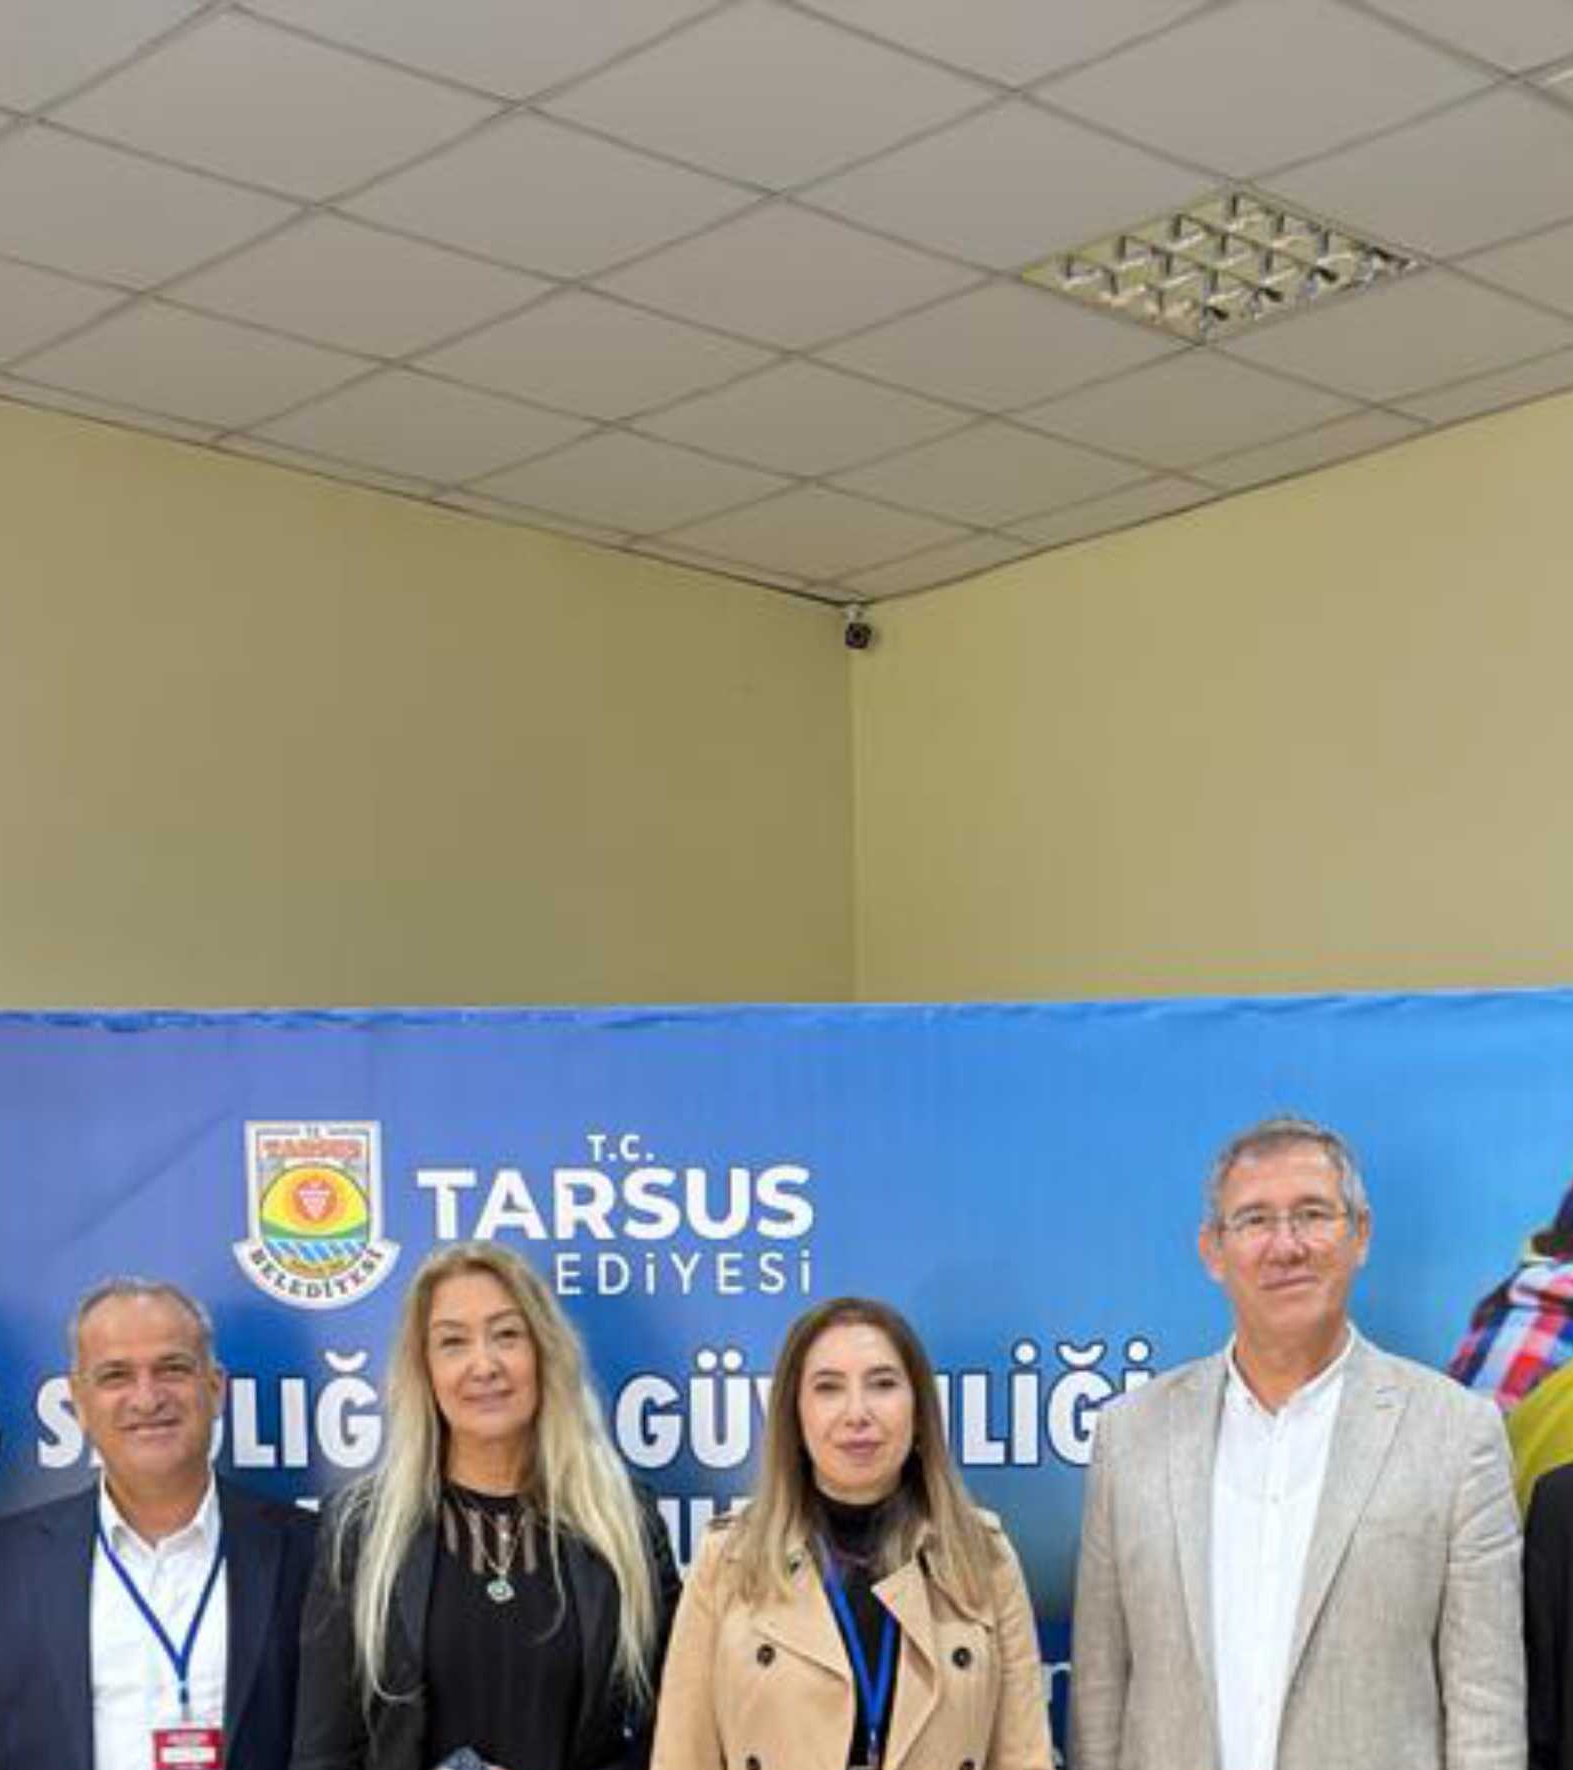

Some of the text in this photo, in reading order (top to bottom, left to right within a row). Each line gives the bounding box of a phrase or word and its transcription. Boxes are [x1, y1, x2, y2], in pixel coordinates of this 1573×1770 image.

[586, 1134, 655, 1162] T.C.
[416, 1166, 814, 1240] TARSUS
[555, 1250, 811, 1296] EDİYESİ
[38, 1350, 382, 1469] SLIĞ
